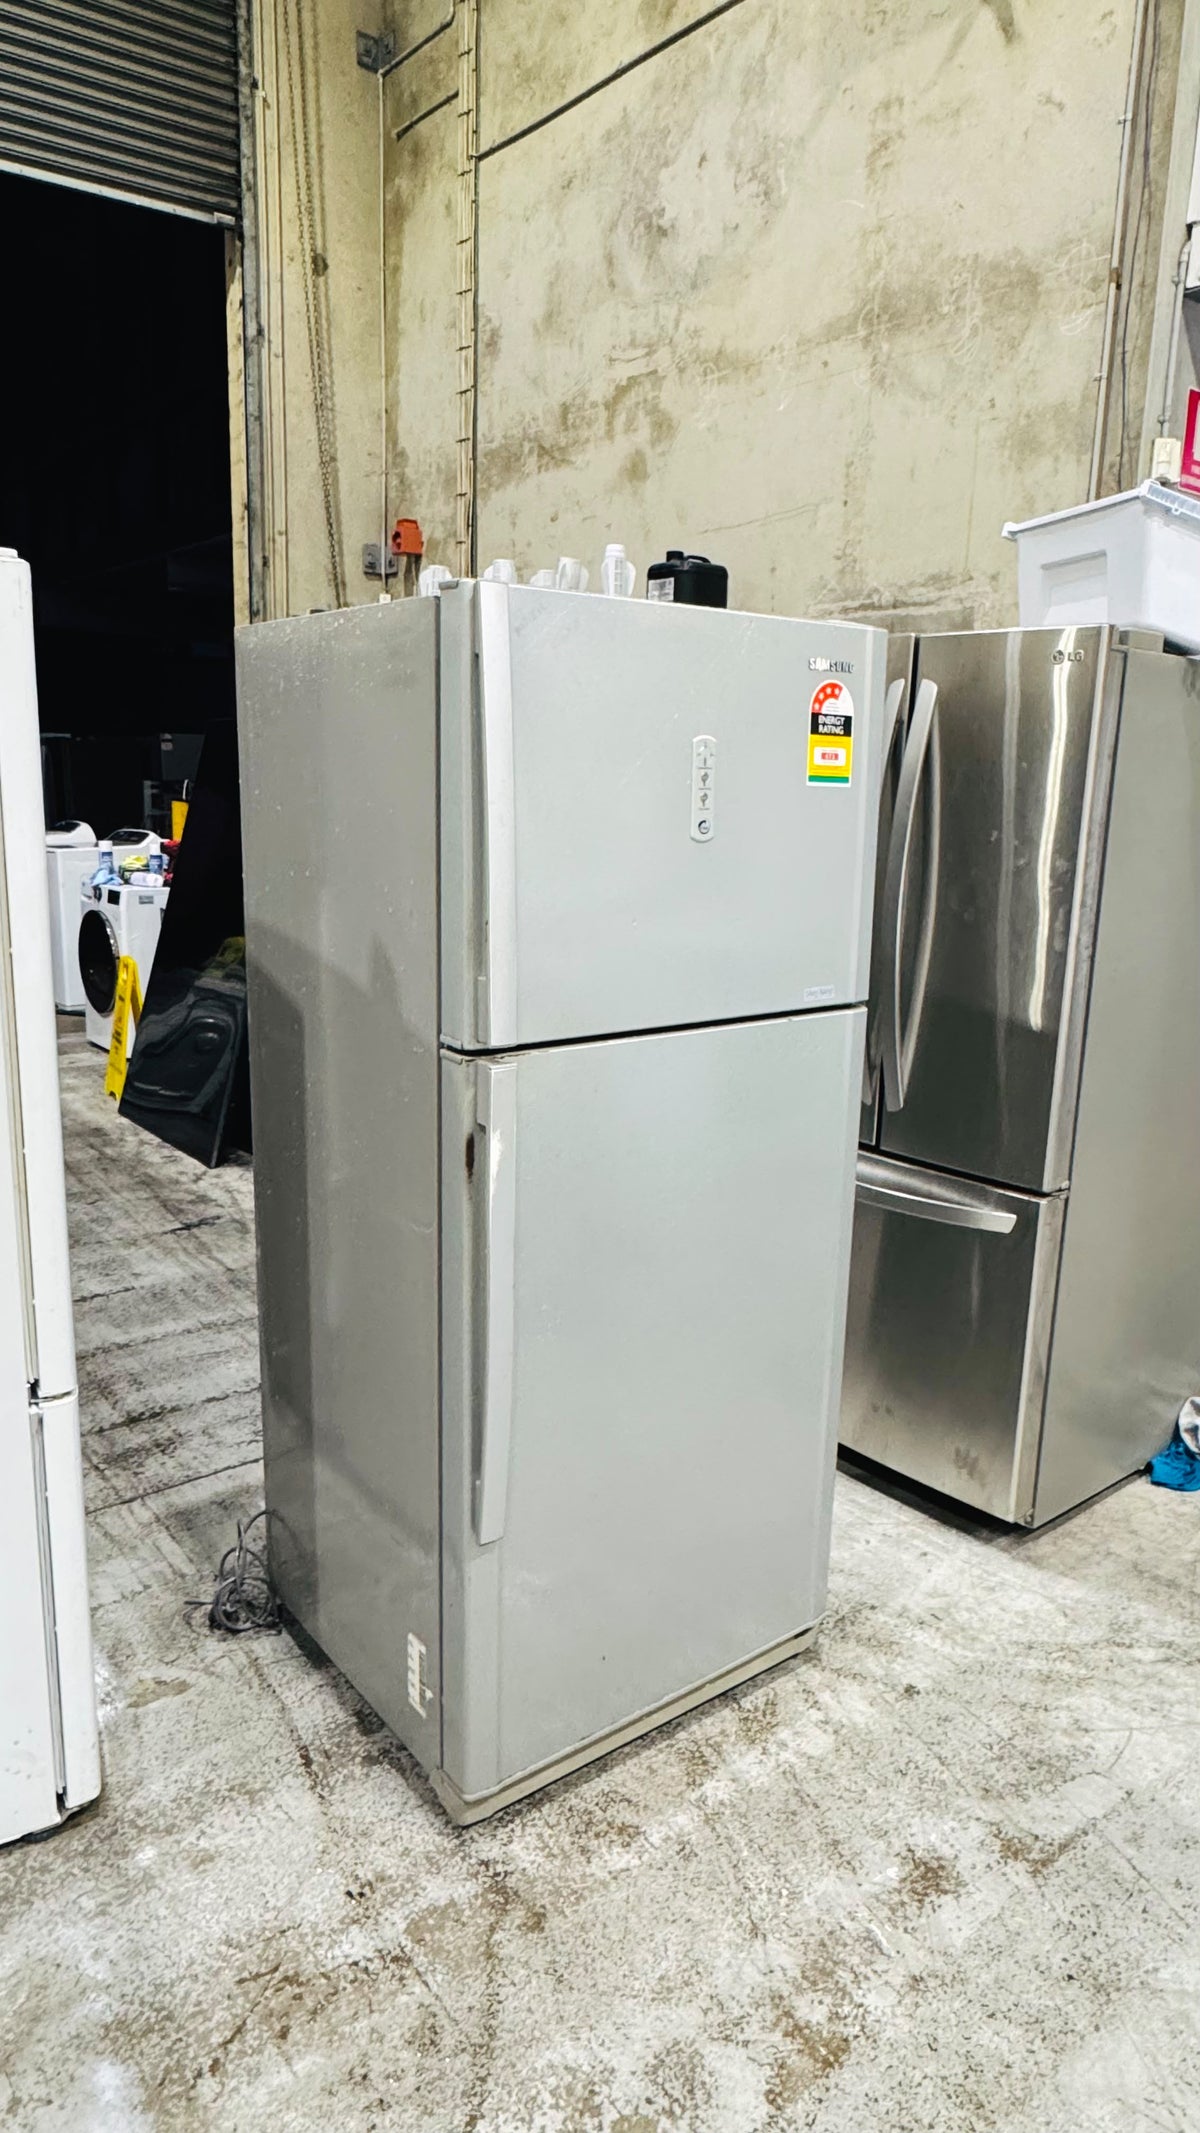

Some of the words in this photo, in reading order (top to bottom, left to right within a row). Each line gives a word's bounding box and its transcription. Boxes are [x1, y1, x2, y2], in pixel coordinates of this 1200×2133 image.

[1067, 651, 1082, 662] LG
[808, 657, 854, 673] SAMSUNG
[818, 715, 845, 725] ENERGY
[818, 724, 845, 735] RATING
